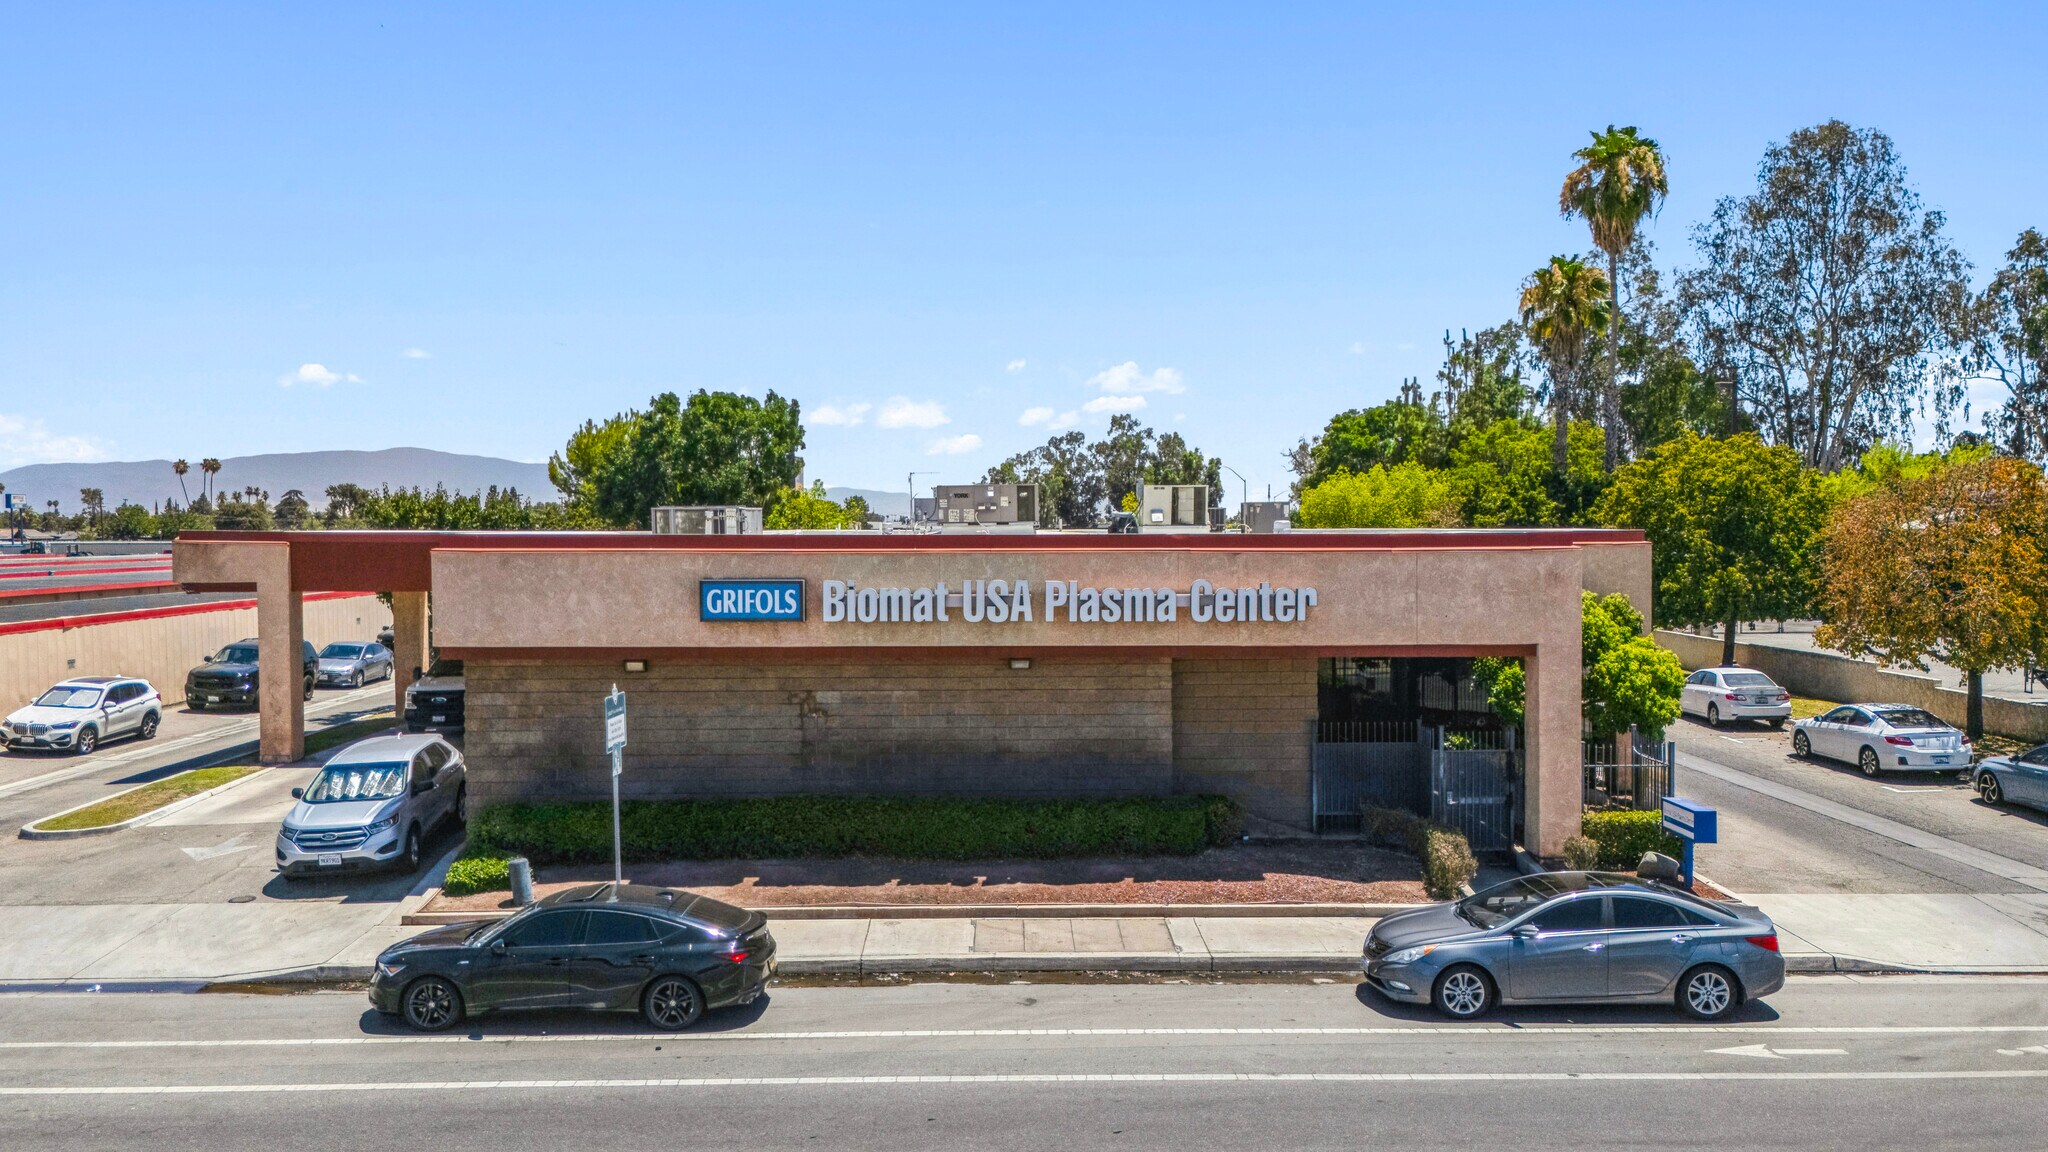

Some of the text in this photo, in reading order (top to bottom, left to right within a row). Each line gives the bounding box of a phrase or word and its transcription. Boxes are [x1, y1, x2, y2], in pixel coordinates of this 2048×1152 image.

[706, 588, 797, 614] GRIFOLS
[822, 578, 1318, 623] Biomat USA Plasma Center
